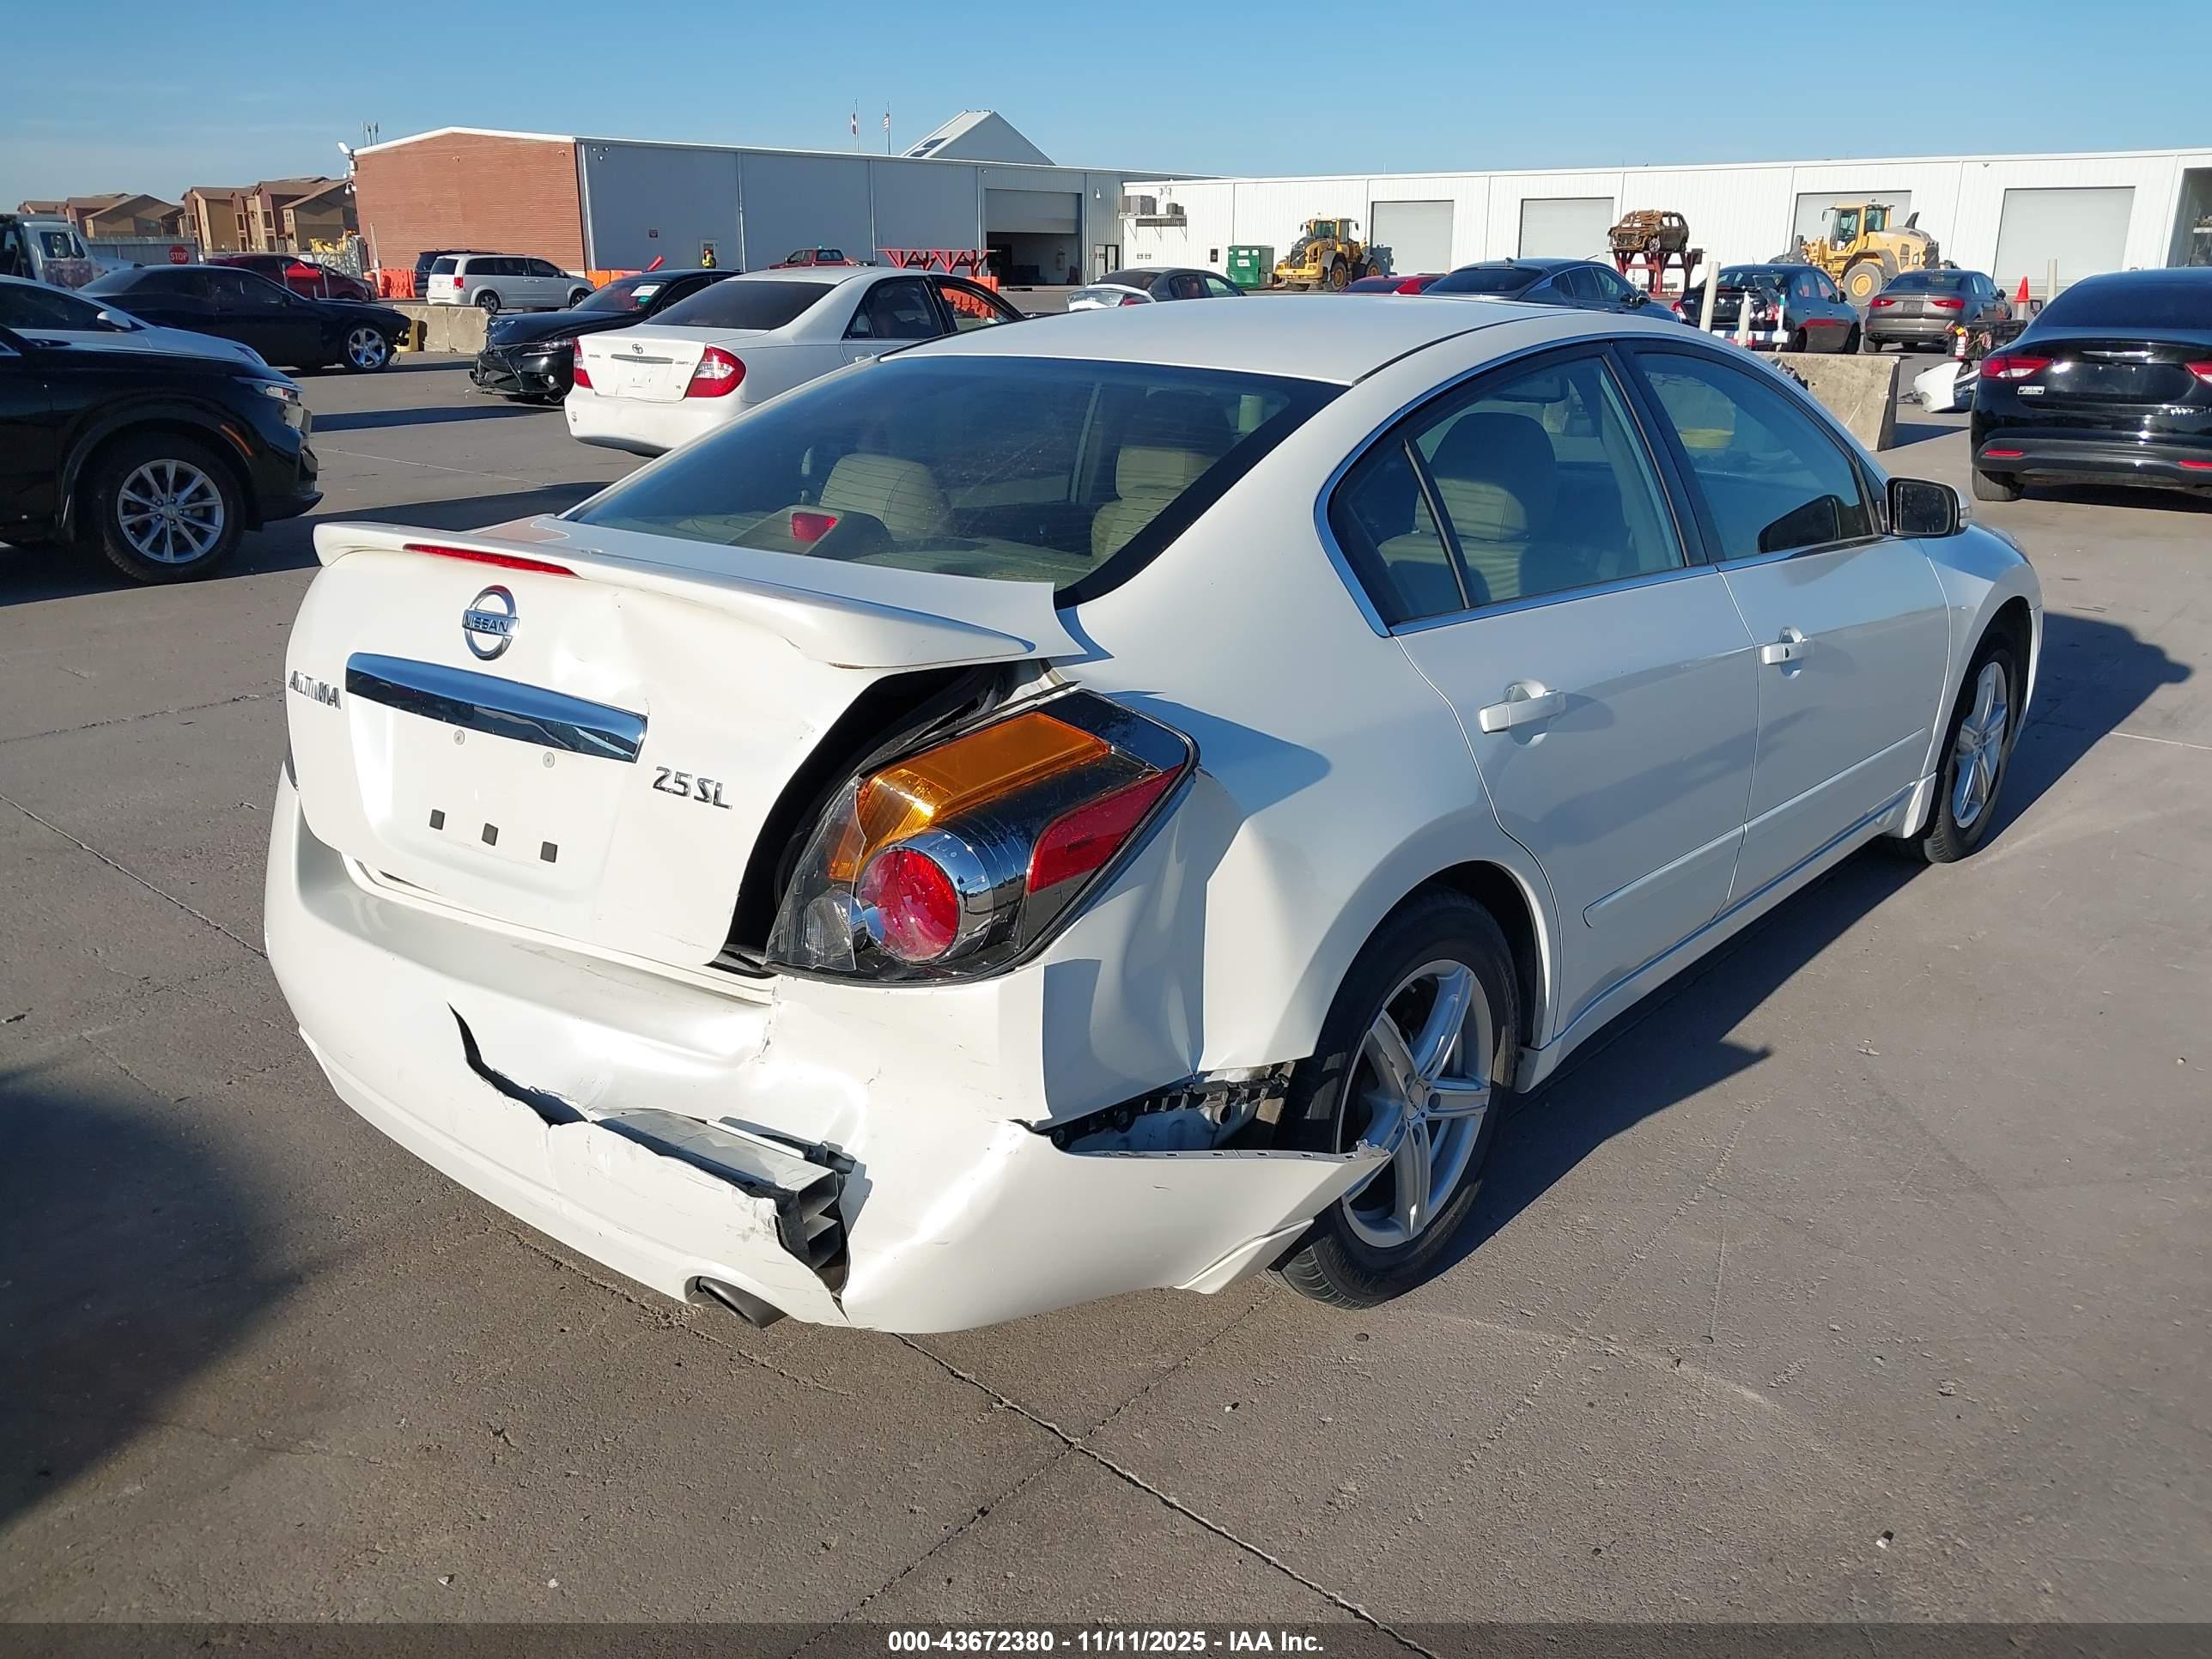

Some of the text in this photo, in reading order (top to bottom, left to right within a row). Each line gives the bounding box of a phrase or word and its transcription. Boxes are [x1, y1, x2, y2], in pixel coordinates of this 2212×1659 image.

[170, 252, 188, 261] STOP
[465, 612, 509, 633] NISSAN
[289, 670, 341, 710] ALTIMA
